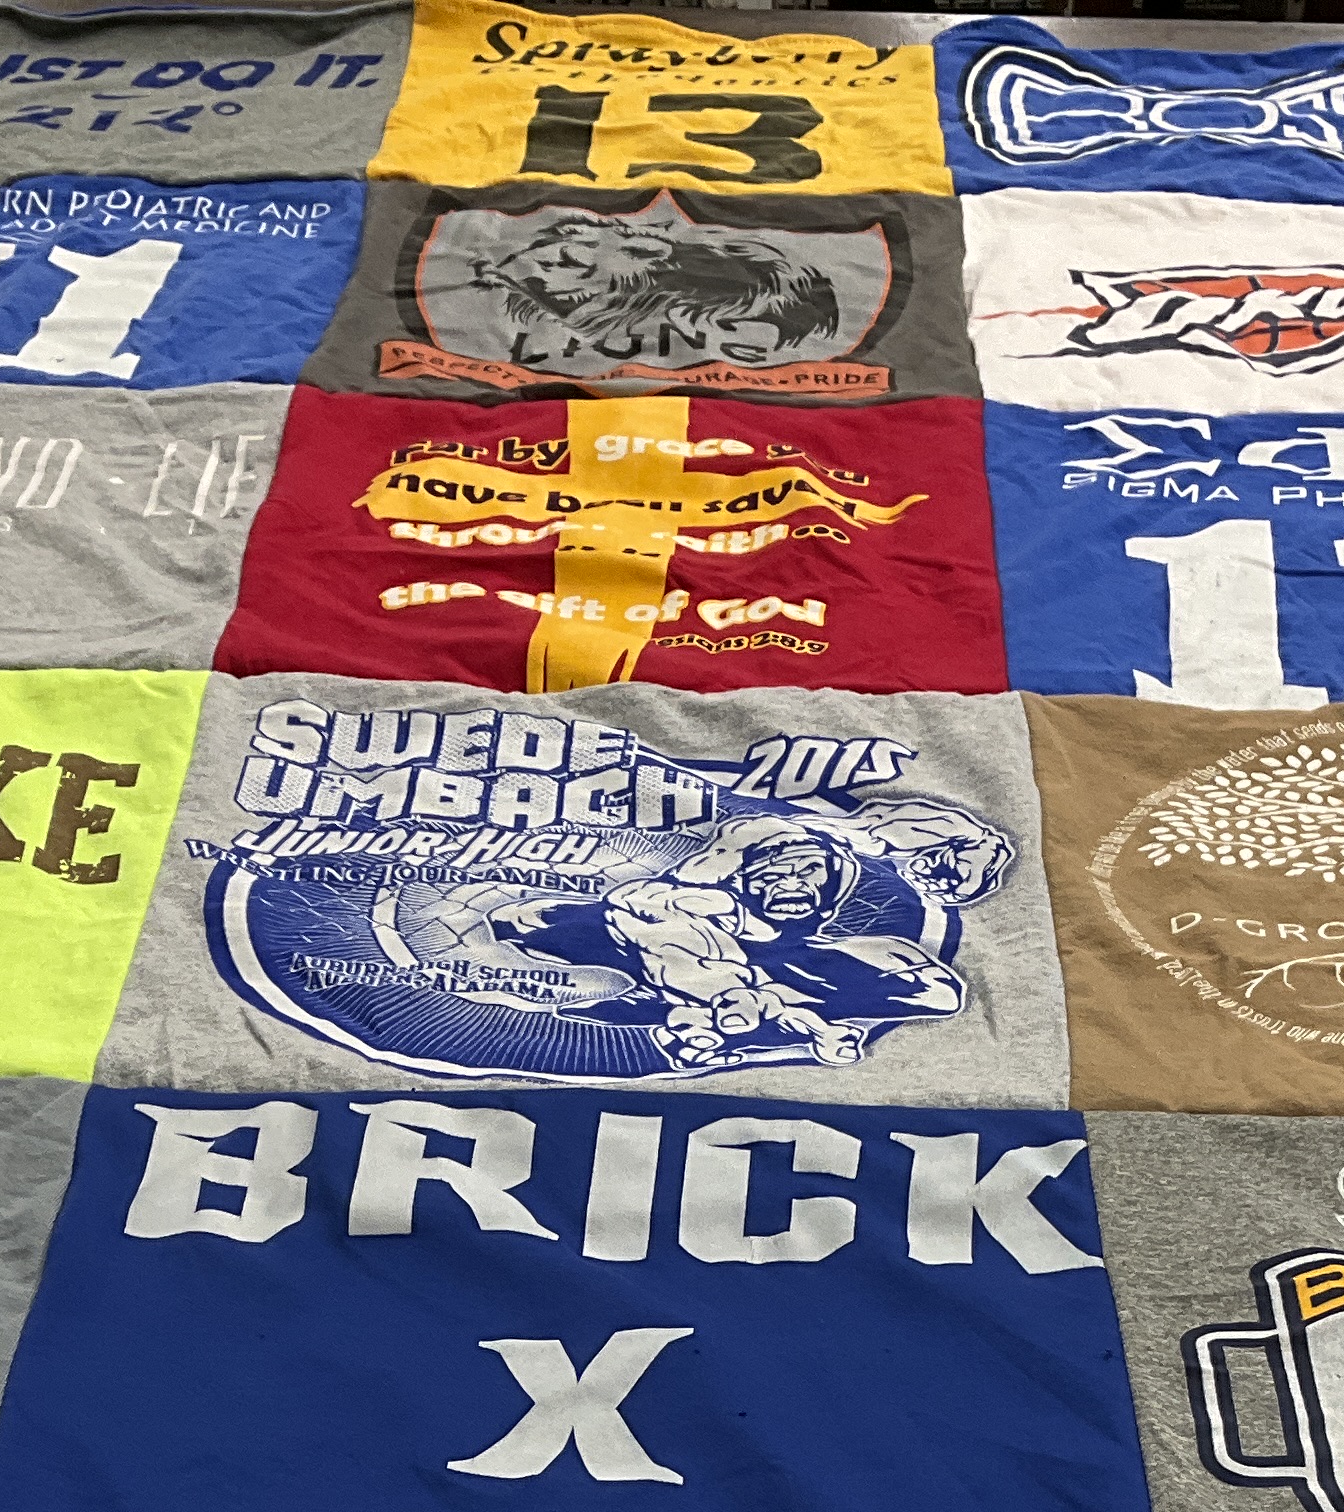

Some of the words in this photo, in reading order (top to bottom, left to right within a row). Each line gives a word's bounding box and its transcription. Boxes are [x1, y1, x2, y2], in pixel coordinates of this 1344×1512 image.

[132, 59, 277, 91] DO
[294, 53, 385, 89] IT.
[520, 84, 824, 183] 13
[69, 189, 248, 218] PEDIATRIC
[259, 201, 332, 220] AND
[130, 218, 322, 239] MEDICINE
[793, 371, 881, 387] PRIDE
[497, 436, 571, 471] by
[593, 434, 755, 462] grace
[765, 443, 870, 487] yu
[385, 472, 527, 505] have
[1061, 471, 1240, 503] SIGMA
[377, 579, 488, 612] the
[623, 588, 691, 623] of
[697, 595, 828, 631] God
[249, 697, 635, 775] SWEDE
[730, 734, 920, 798] 2015
[1293, 717, 1335, 741] sends
[232, 755, 720, 833] UMBACH
[231, 819, 450, 864] JUNIOR
[452, 828, 606, 867] HIGH
[184, 837, 369, 885] WRESTLING
[378, 863, 605, 894] TOURNAMENT
[291, 952, 405, 976] AUBURN
[412, 957, 472, 976] HIGH
[478, 964, 577, 989] SCHOOL
[431, 972, 560, 999] ALABAMA
[122, 1098, 1106, 1275] BRICK
